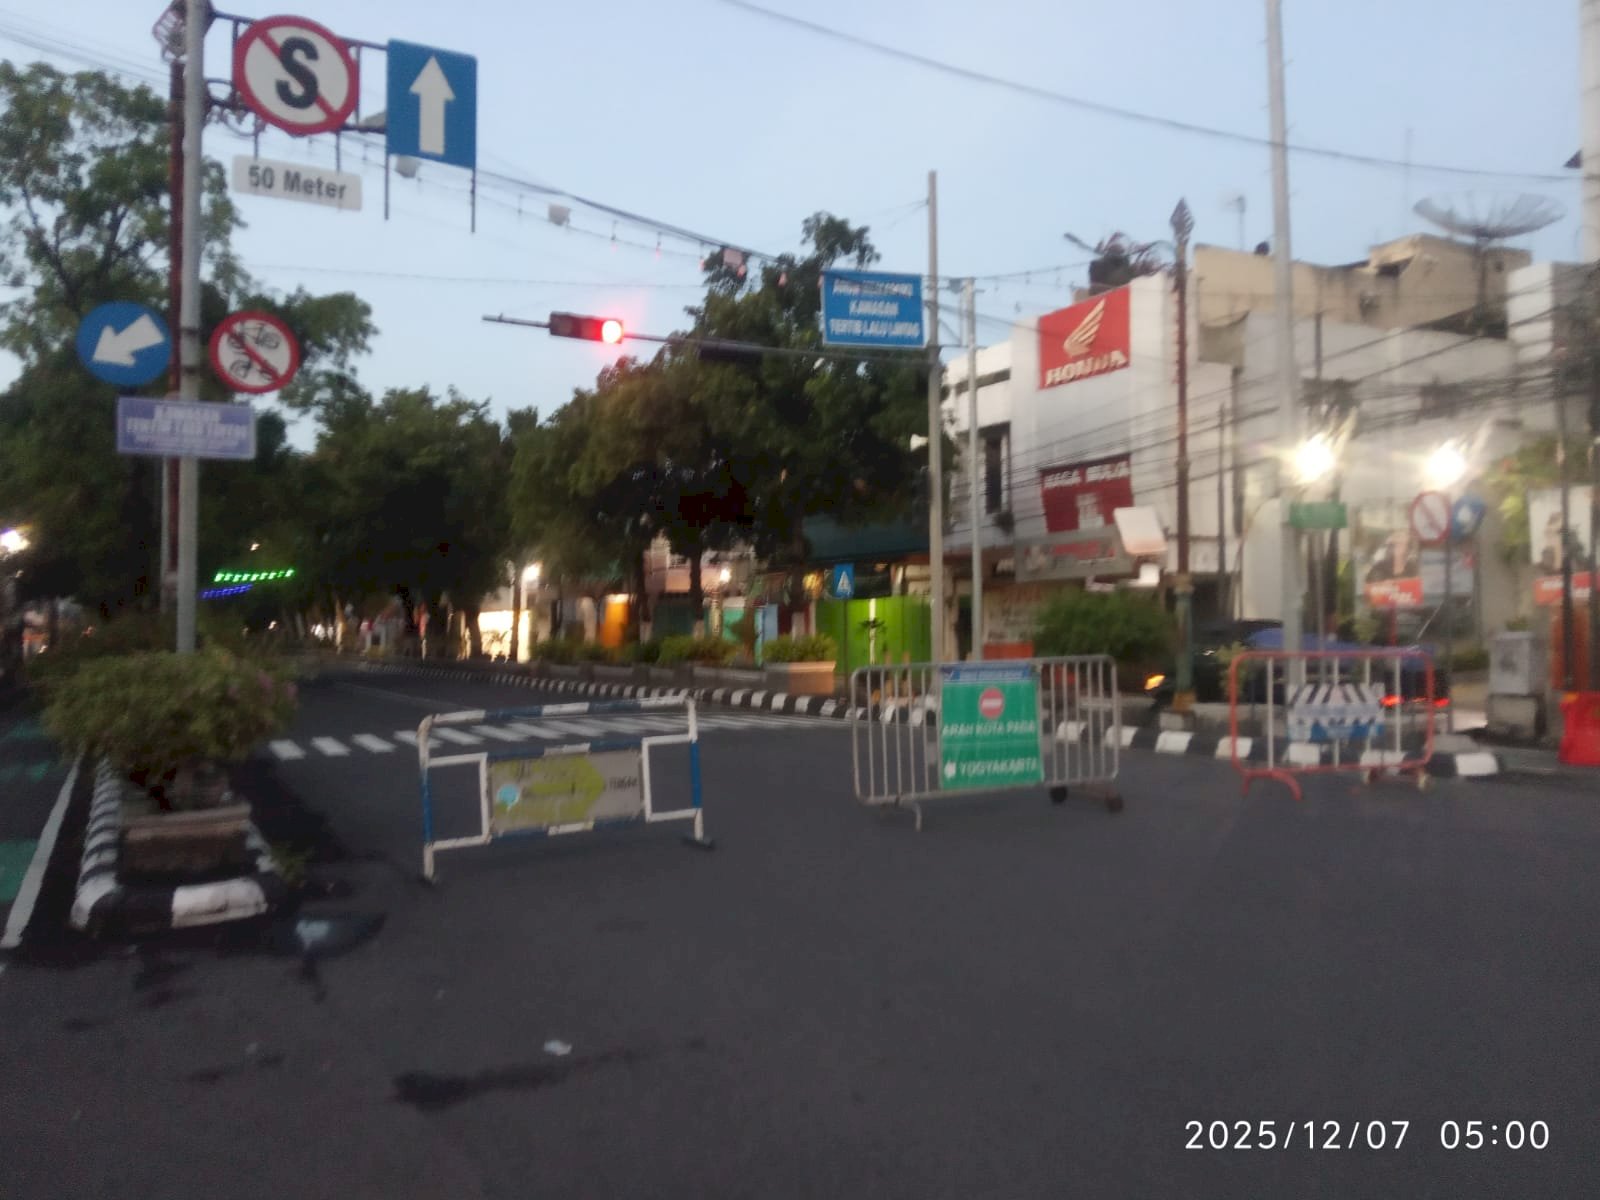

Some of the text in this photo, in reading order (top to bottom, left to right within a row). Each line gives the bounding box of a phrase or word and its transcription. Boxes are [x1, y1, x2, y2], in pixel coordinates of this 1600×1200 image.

[275, 36, 320, 110] S
[248, 164, 347, 200] 50 Meter
[961, 757, 1038, 776] YOGYAKARTA
